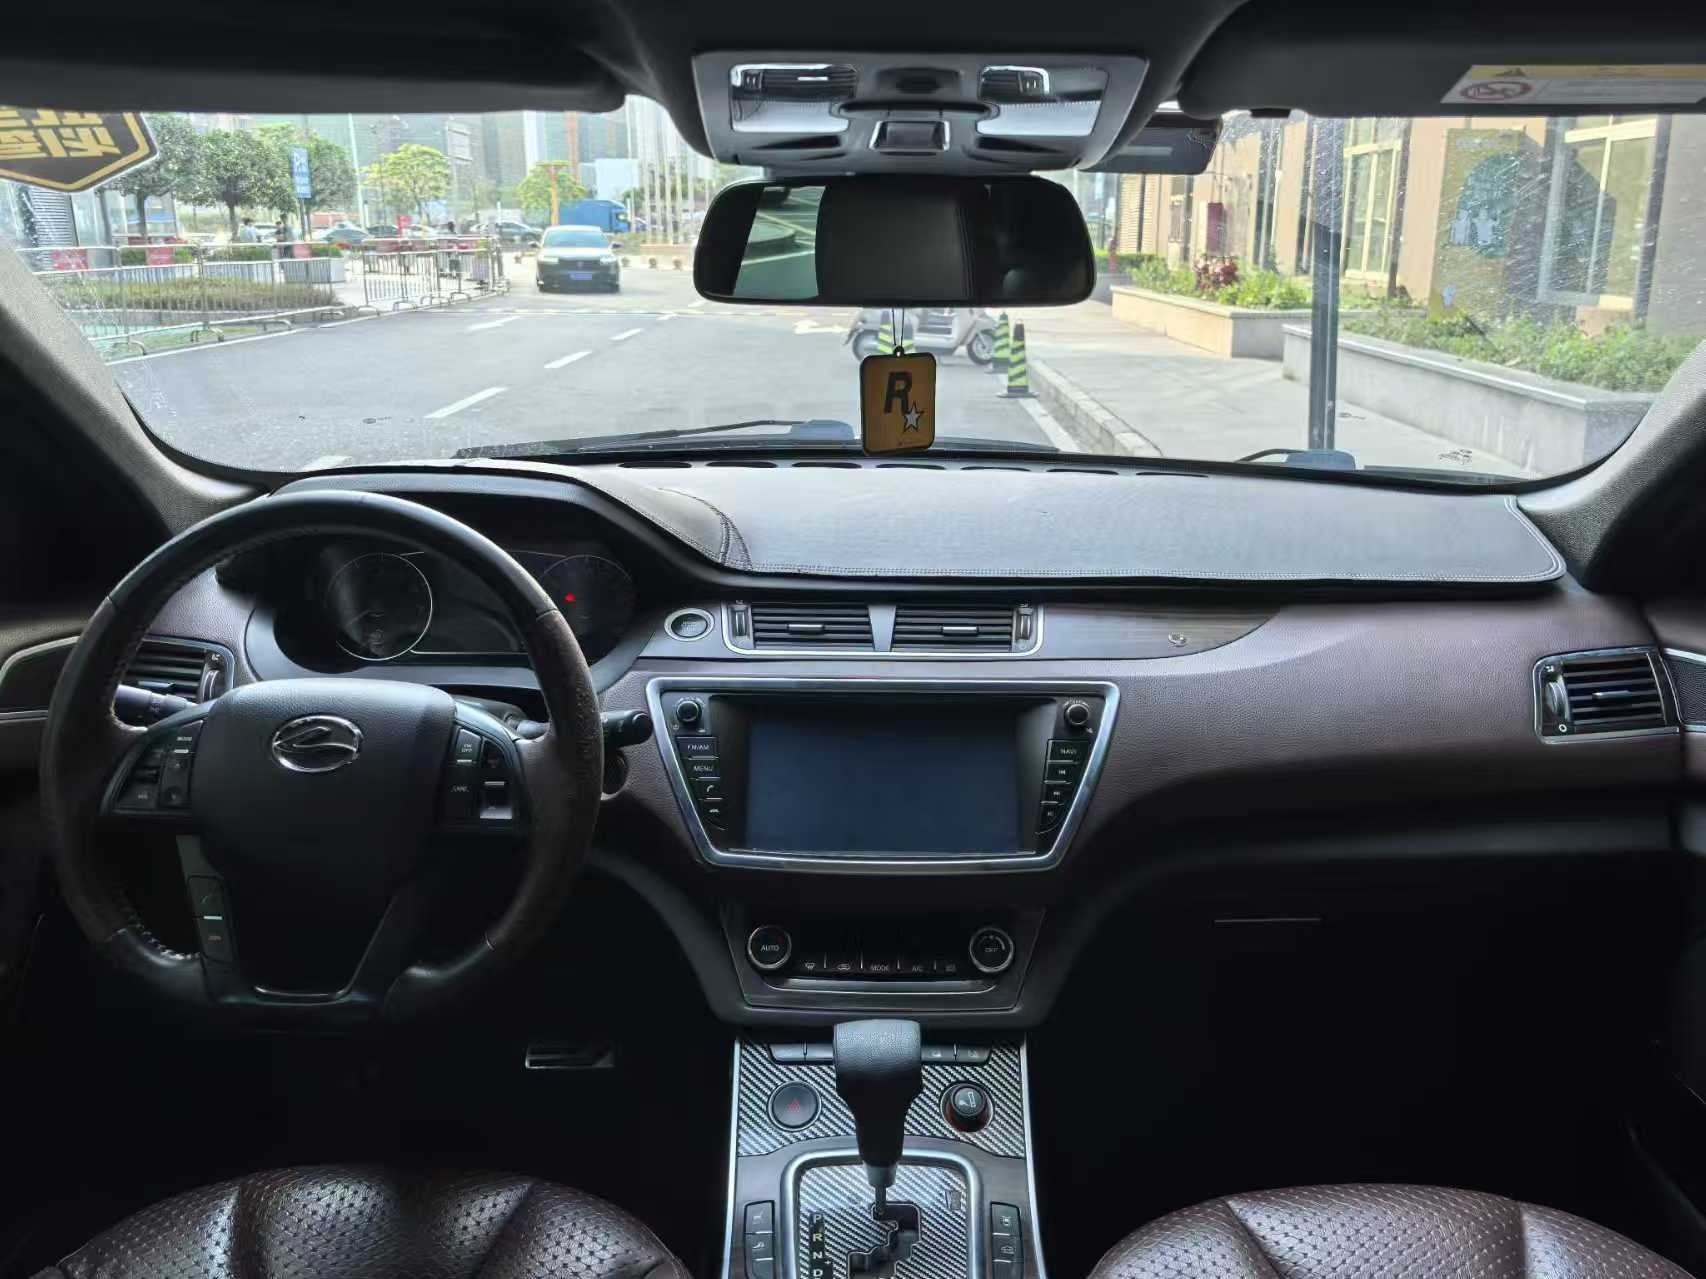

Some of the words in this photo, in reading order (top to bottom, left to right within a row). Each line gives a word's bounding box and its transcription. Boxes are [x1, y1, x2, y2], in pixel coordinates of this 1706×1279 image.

[884, 371, 913, 414] R
[693, 764, 714, 772] MENU
[761, 943, 780, 952] AUTO
[813, 1214, 822, 1224] P
[812, 1233, 823, 1242] R
[812, 1251, 823, 1260] N
[812, 1268, 823, 1278] D
